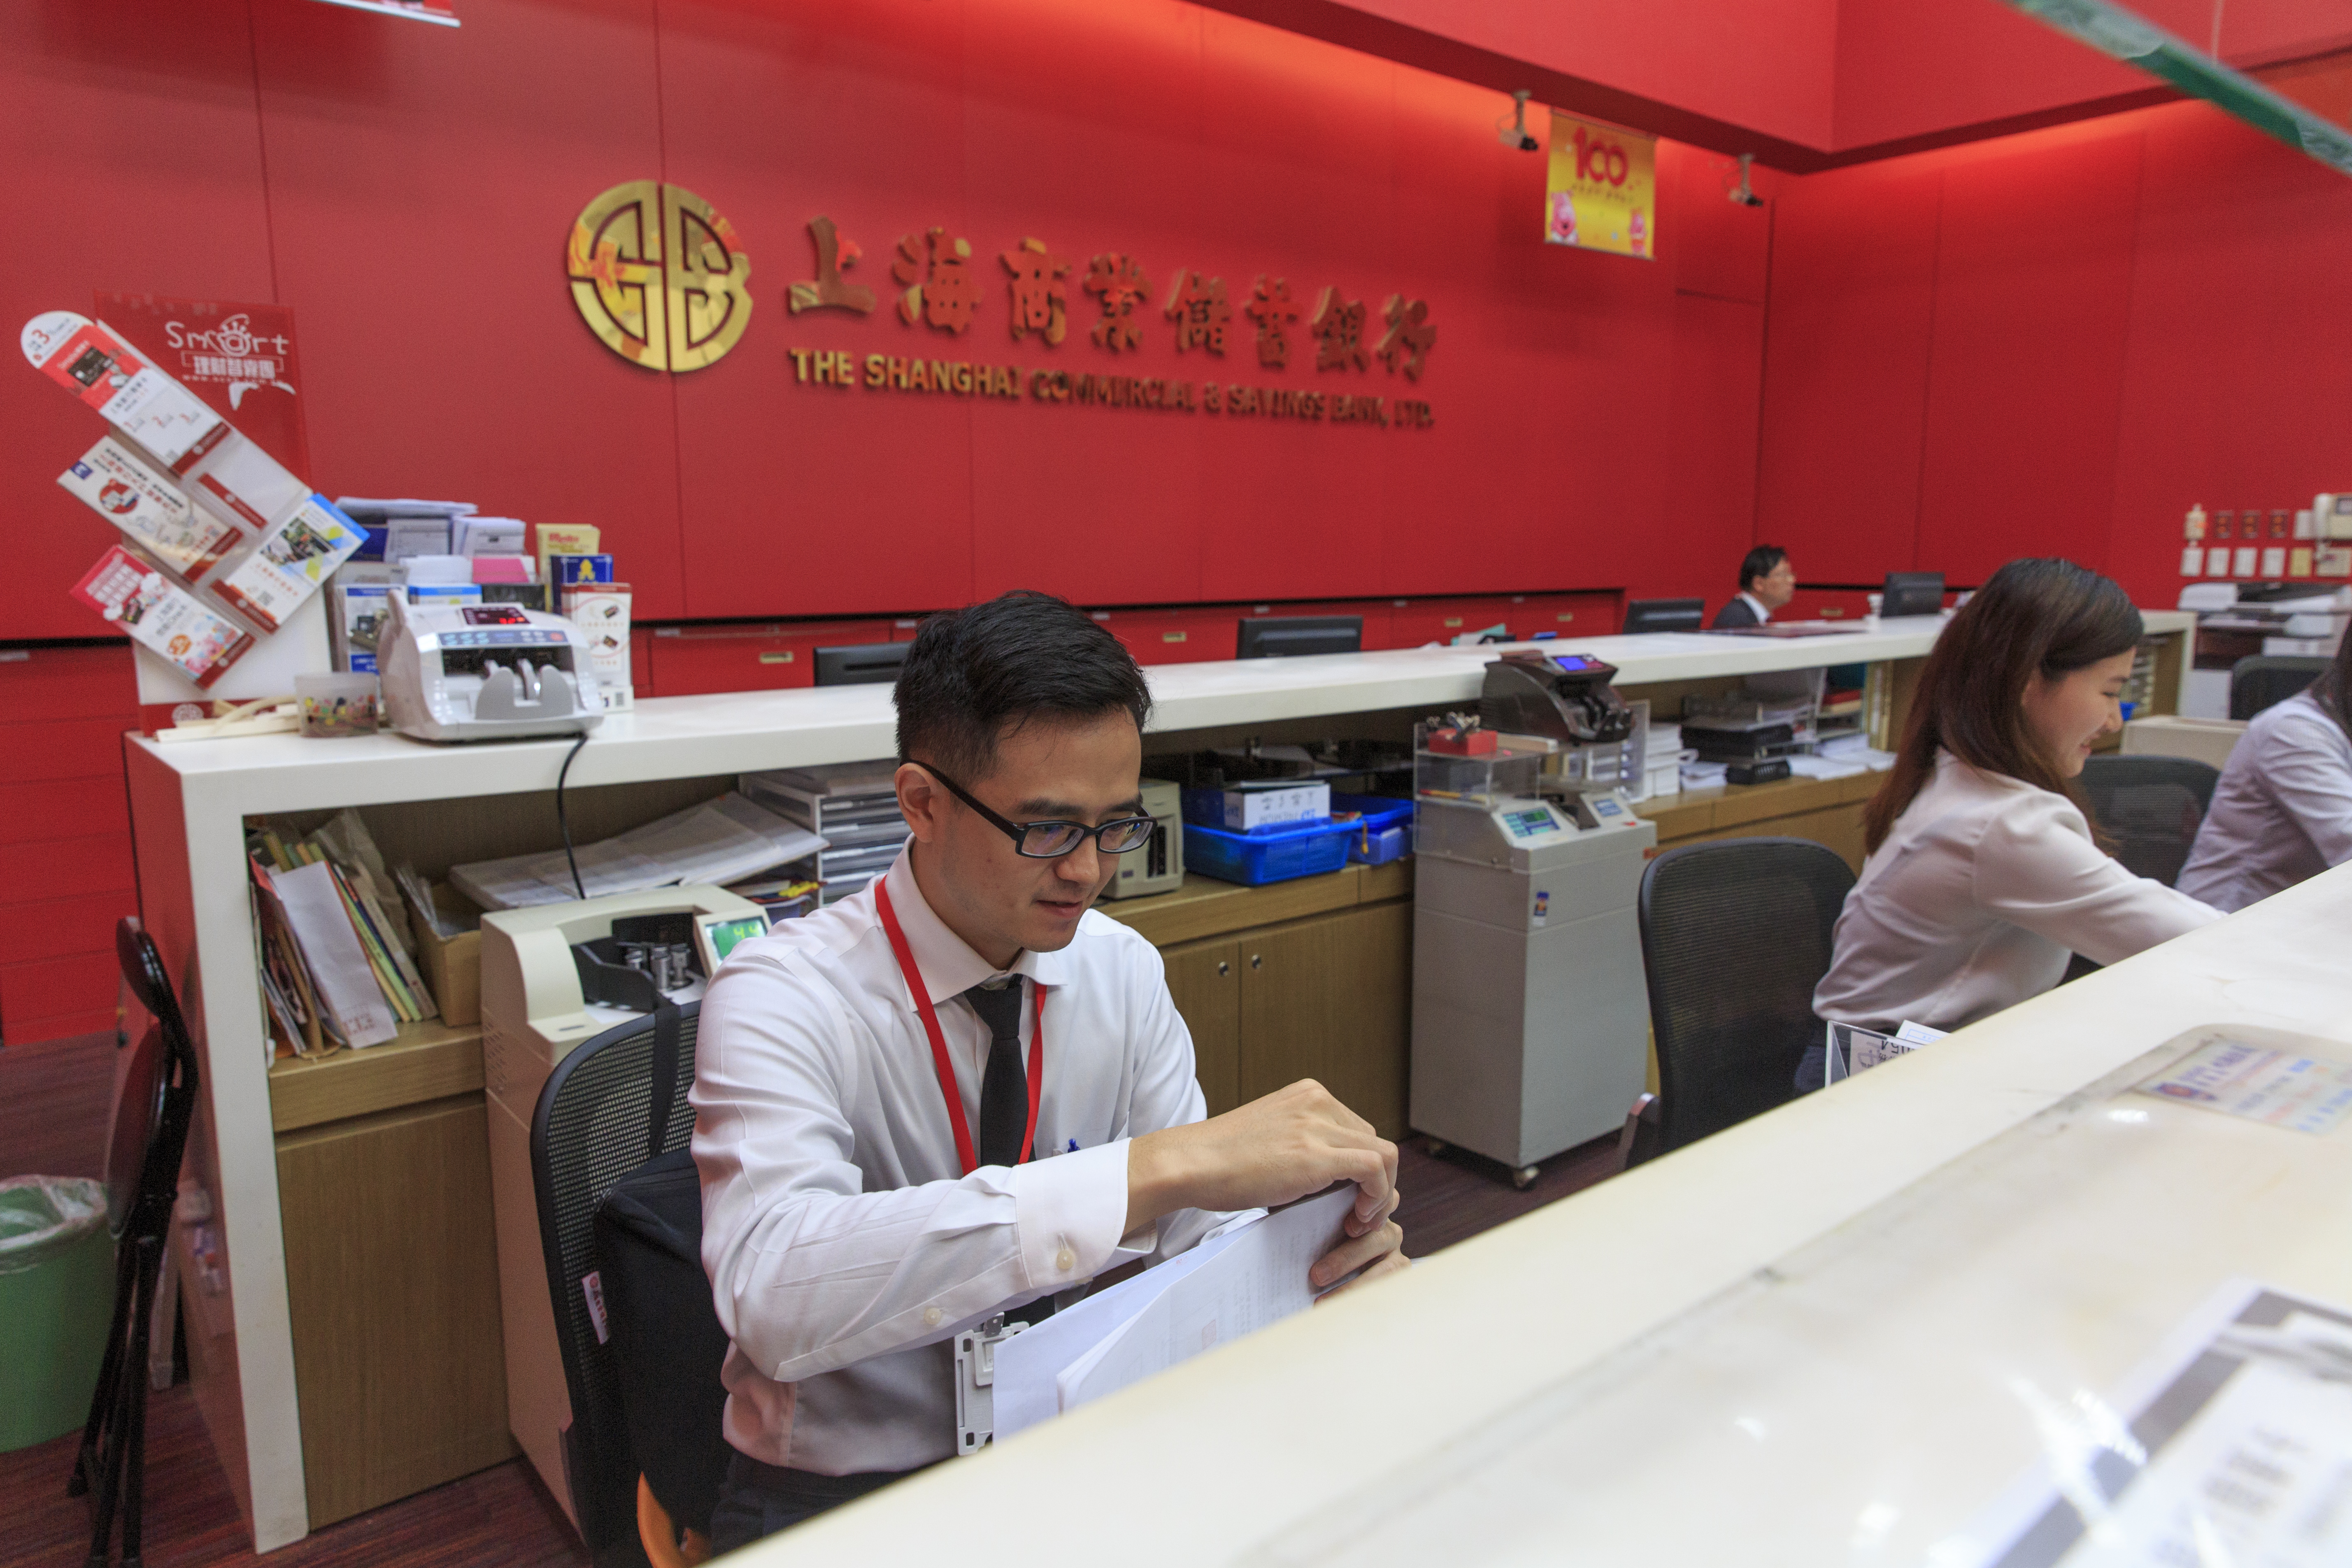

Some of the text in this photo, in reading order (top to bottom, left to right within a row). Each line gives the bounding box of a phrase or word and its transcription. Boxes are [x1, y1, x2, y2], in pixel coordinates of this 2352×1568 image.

[1573, 126, 1628, 186] 100
[787, 215, 1436, 383] 上海商業儲蓄銀行
[790, 348, 855, 385] THE
[866, 353, 1024, 396] SHANGHAI
[1205, 382, 1221, 412] &
[1228, 384, 1325, 420] SAVINGS
